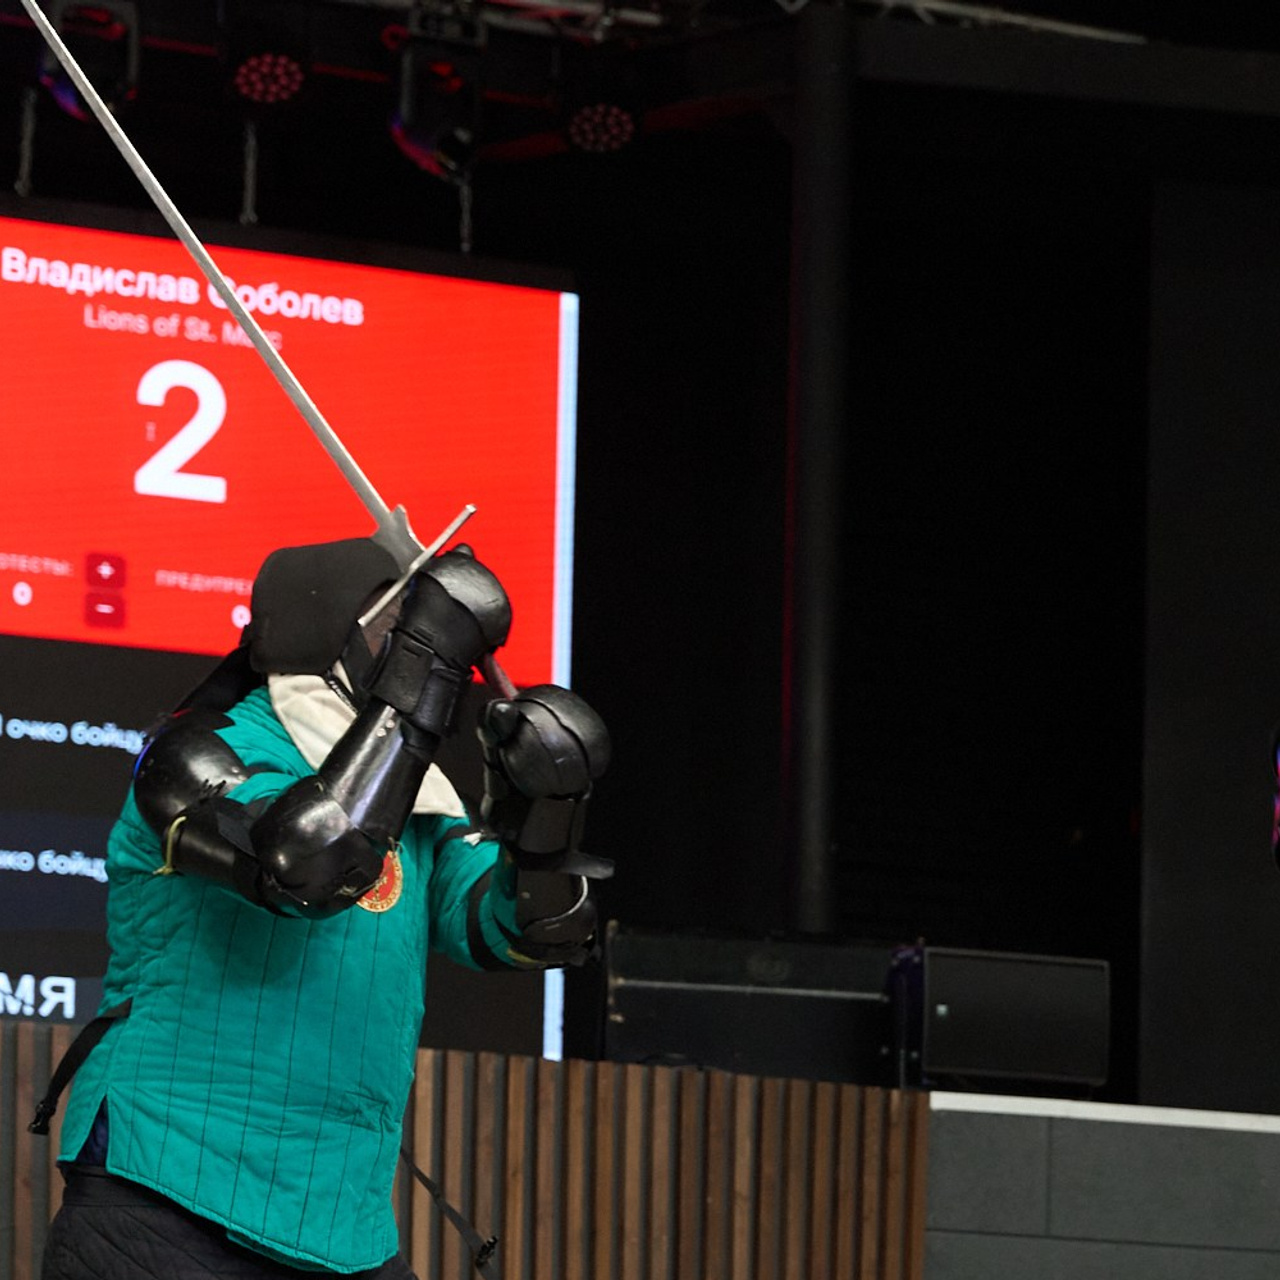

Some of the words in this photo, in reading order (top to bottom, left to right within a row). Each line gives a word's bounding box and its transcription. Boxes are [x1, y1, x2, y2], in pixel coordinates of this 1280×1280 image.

[1, 246, 200, 305] Владислав
[83, 302, 150, 335] Lions
[152, 312, 181, 338] of
[183, 315, 217, 343] St.
[134, 358, 227, 504] 2
[12, 581, 33, 606] 0
